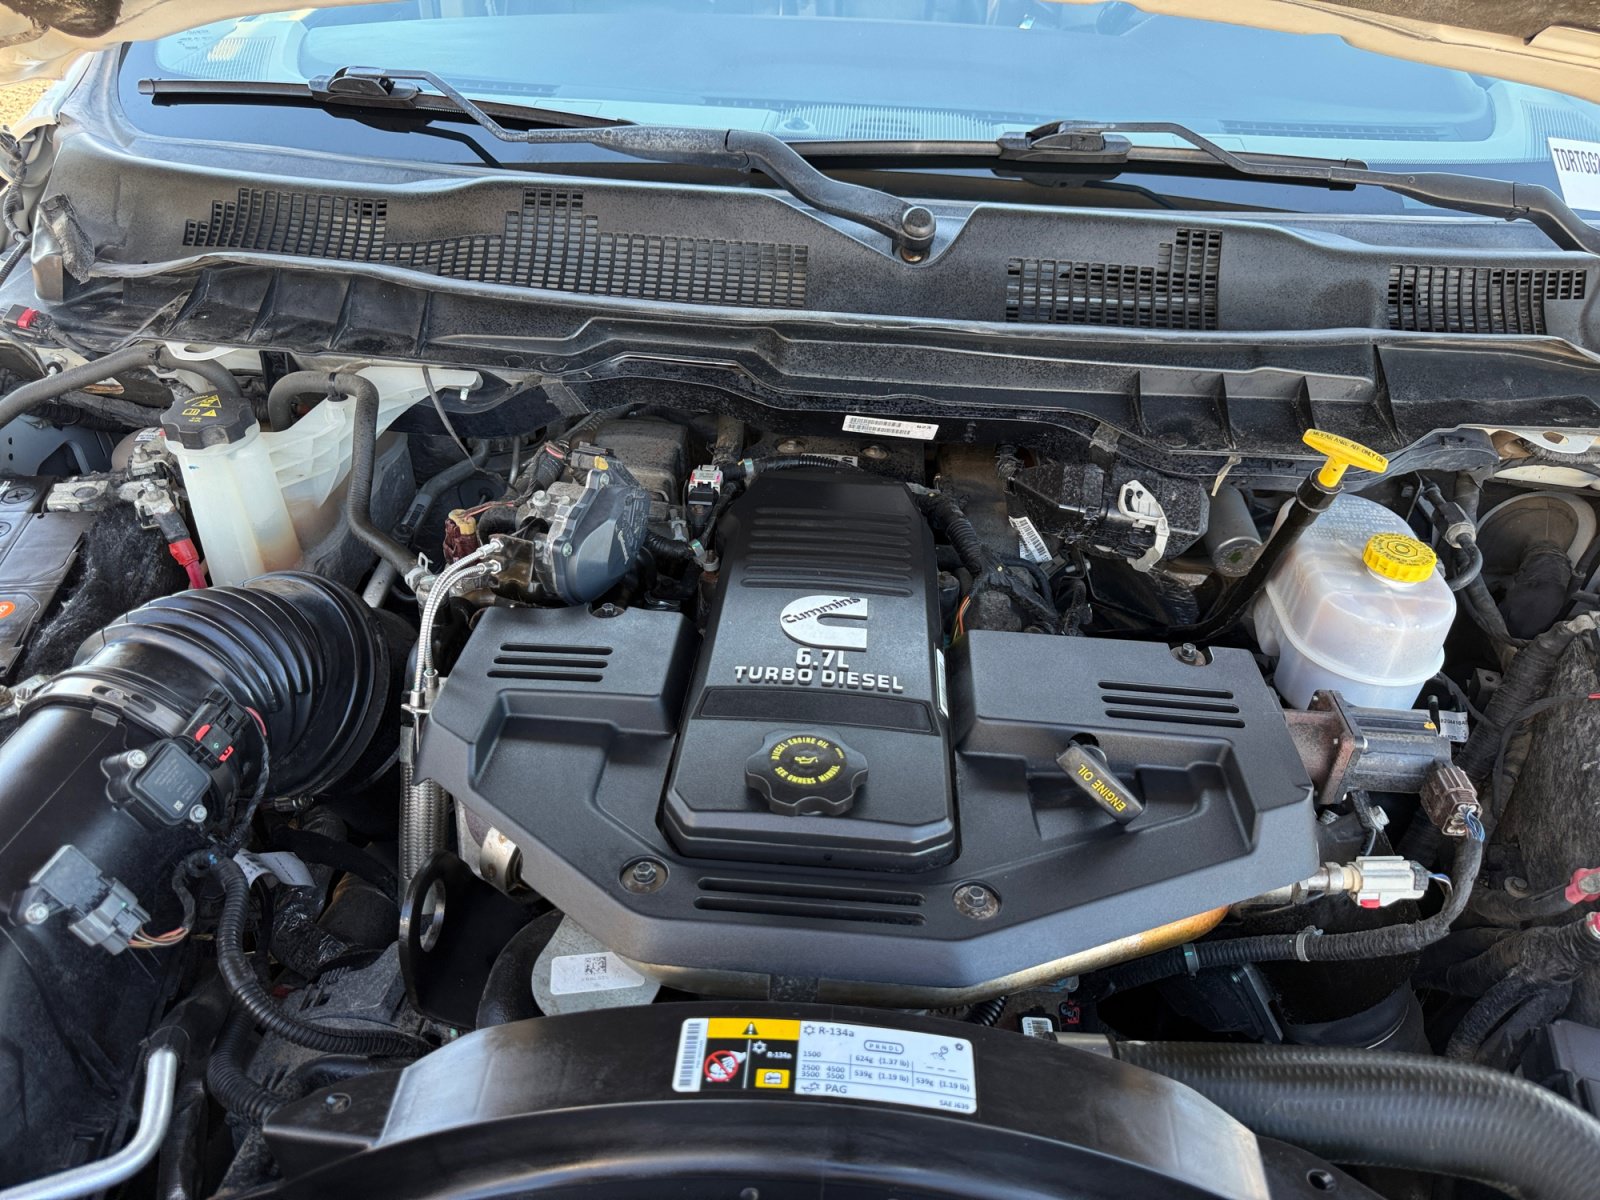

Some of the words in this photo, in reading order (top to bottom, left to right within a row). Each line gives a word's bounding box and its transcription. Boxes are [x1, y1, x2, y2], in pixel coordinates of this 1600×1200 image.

[796, 647, 850, 671] 6.7L
[734, 665, 813, 684] TURBO
[821, 669, 904, 693] DIESEL
[771, 742, 789, 760] DIESEL
[787, 737, 817, 746] ENGINE
[816, 739, 829, 749] OIL
[774, 766, 789, 778] SEE
[817, 765, 841, 782] MANUAL
[1077, 763, 1094, 781] OIL
[1090, 779, 1127, 813] ENGINE
[818, 1026, 855, 1038] R-134a
[766, 1051, 792, 1059] R-134a
[803, 1050, 822, 1058] 1500
[855, 1054, 874, 1064] 624g
[879, 1056, 898, 1066] (1.37
[899, 1059, 910, 1068] lb)
[826, 1065, 845, 1073] 4500
[826, 1072, 845, 1080] 5500
[854, 1069, 873, 1079] 539g
[878, 1071, 898, 1081] (1.19
[899, 1073, 910, 1083] lb)
[825, 1083, 848, 1094] PAG
[915, 1077, 935, 1087] 539g
[939, 1080, 958, 1090] (1.19
[959, 1083, 970, 1092] lb)
[939, 1099, 953, 1107] SAE
